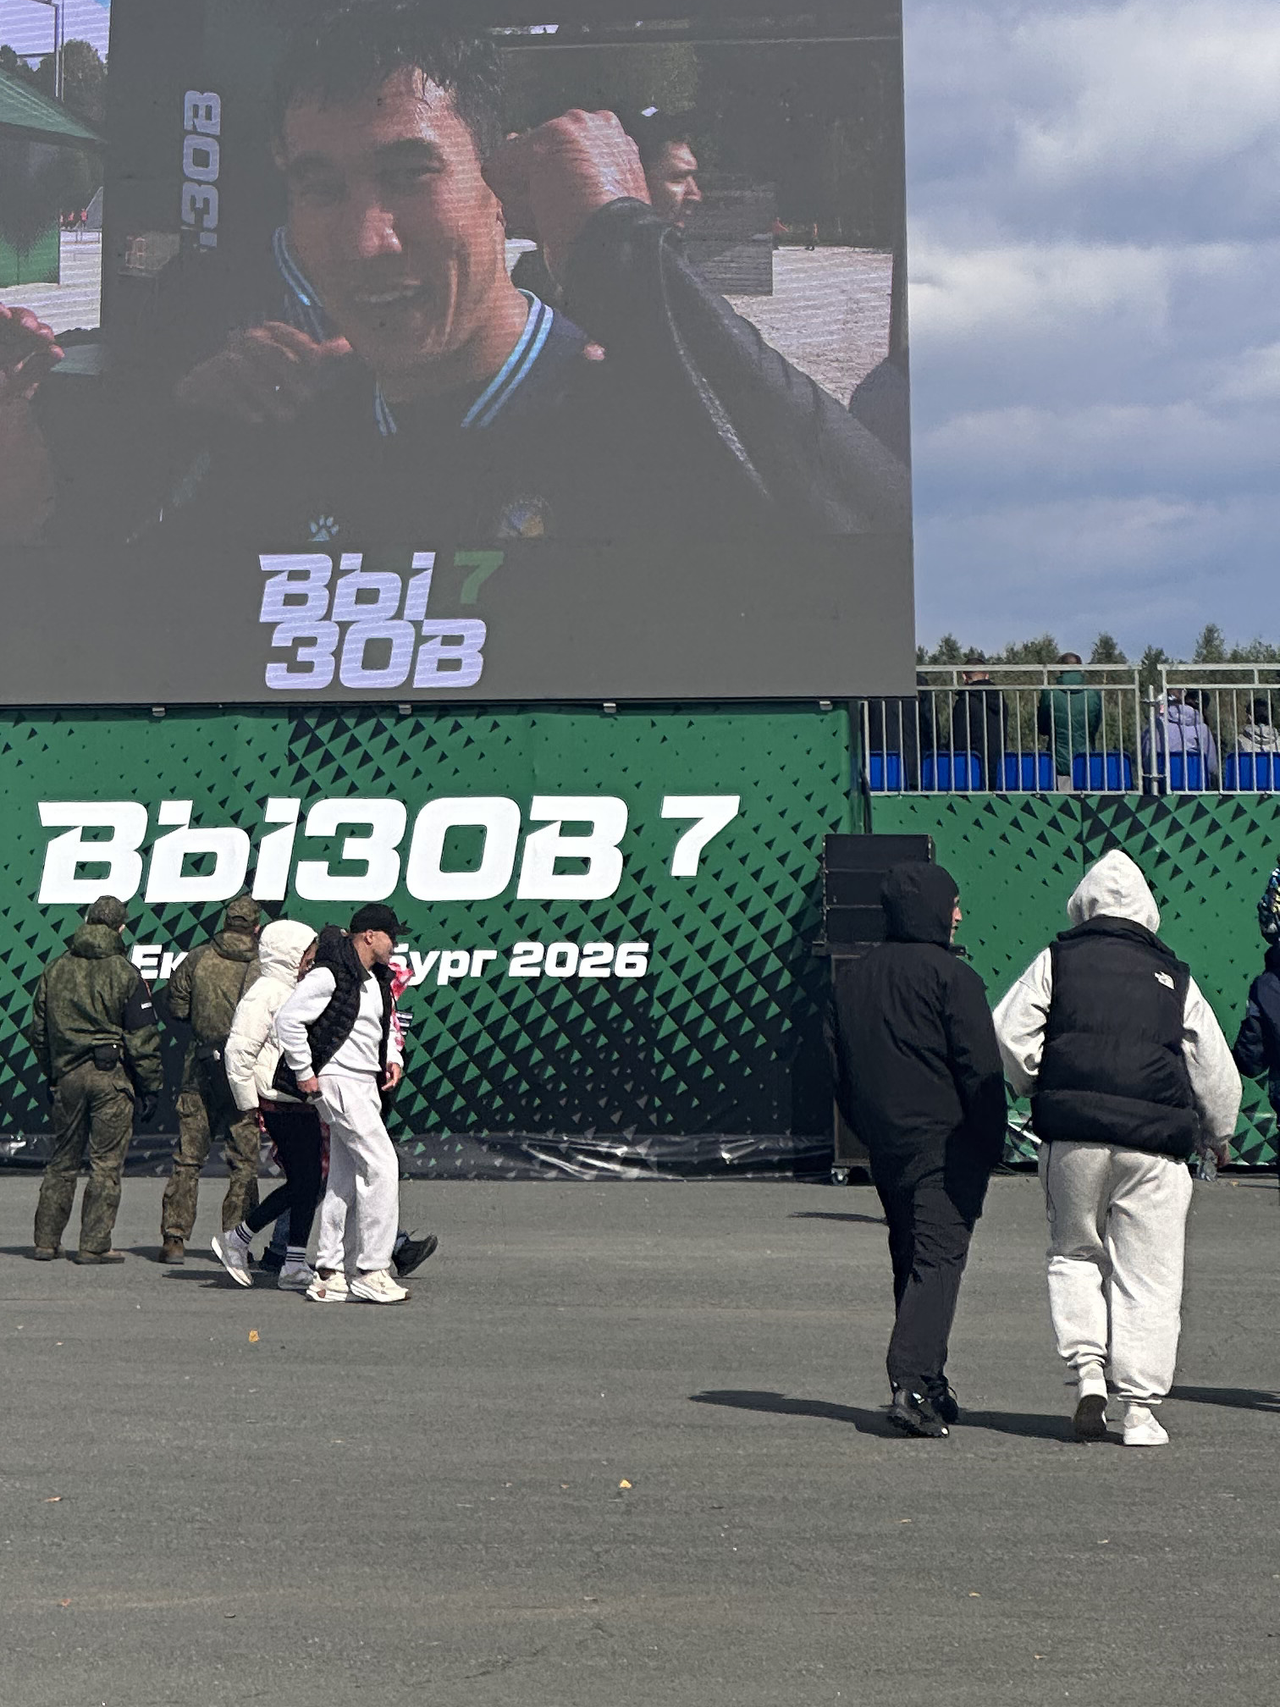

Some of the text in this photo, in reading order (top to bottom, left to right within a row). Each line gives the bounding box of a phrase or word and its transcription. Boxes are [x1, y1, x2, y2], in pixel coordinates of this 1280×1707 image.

[453, 551, 504, 604] 7
[265, 619, 487, 690] ЗОВ
[38, 795, 741, 905] ВЫЗОВ 7
[508, 941, 649, 979] 2026
